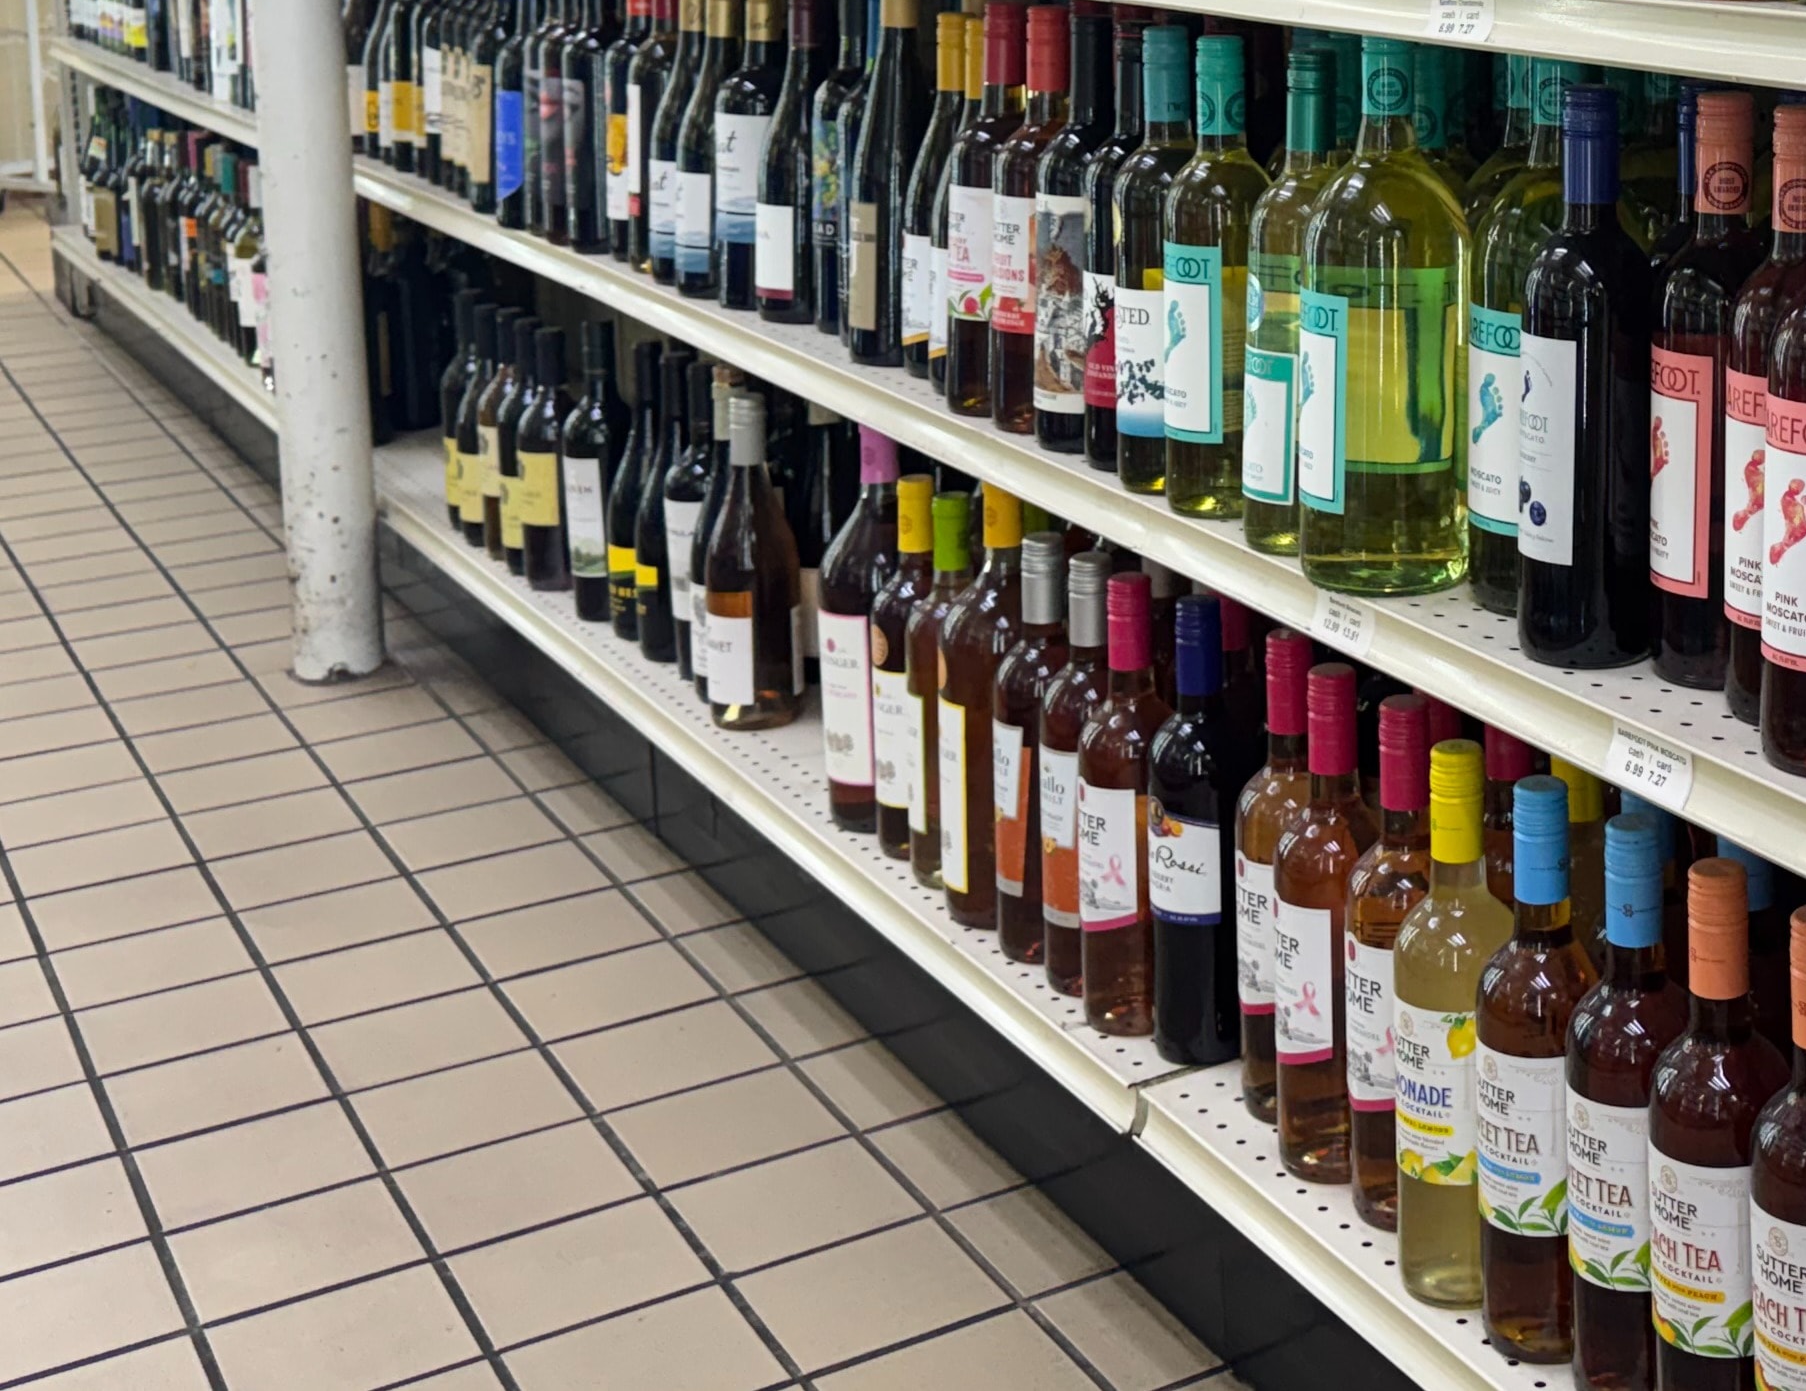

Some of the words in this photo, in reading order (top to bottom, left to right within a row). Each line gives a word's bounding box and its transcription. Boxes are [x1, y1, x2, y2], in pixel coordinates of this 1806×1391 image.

[1739, 556, 1762, 571] PINK
[1775, 592, 1798, 607] PINK
[1617, 728, 1646, 746] BAREFOOT
[1660, 745, 1687, 765] MOSCATO
[1628, 747, 1644, 760] cash
[1657, 760, 1672, 773] card
[1624, 760, 1644, 777] 6.99
[1647, 770, 1666, 787] 7.27
[1506, 1127, 1539, 1154] TEA
[1484, 1144, 1529, 1166] COCKTAIL
[1569, 1144, 1601, 1166] HOME
[1597, 1179, 1632, 1208] TEA
[1652, 1189, 1697, 1219] SUTTER
[1575, 1197, 1622, 1218] COCKTAIL
[1655, 1202, 1692, 1231] HOME
[1682, 1243, 1721, 1273] TEA
[1662, 1264, 1714, 1285] COCKTAIL
[1760, 1266, 1803, 1295] HOME
